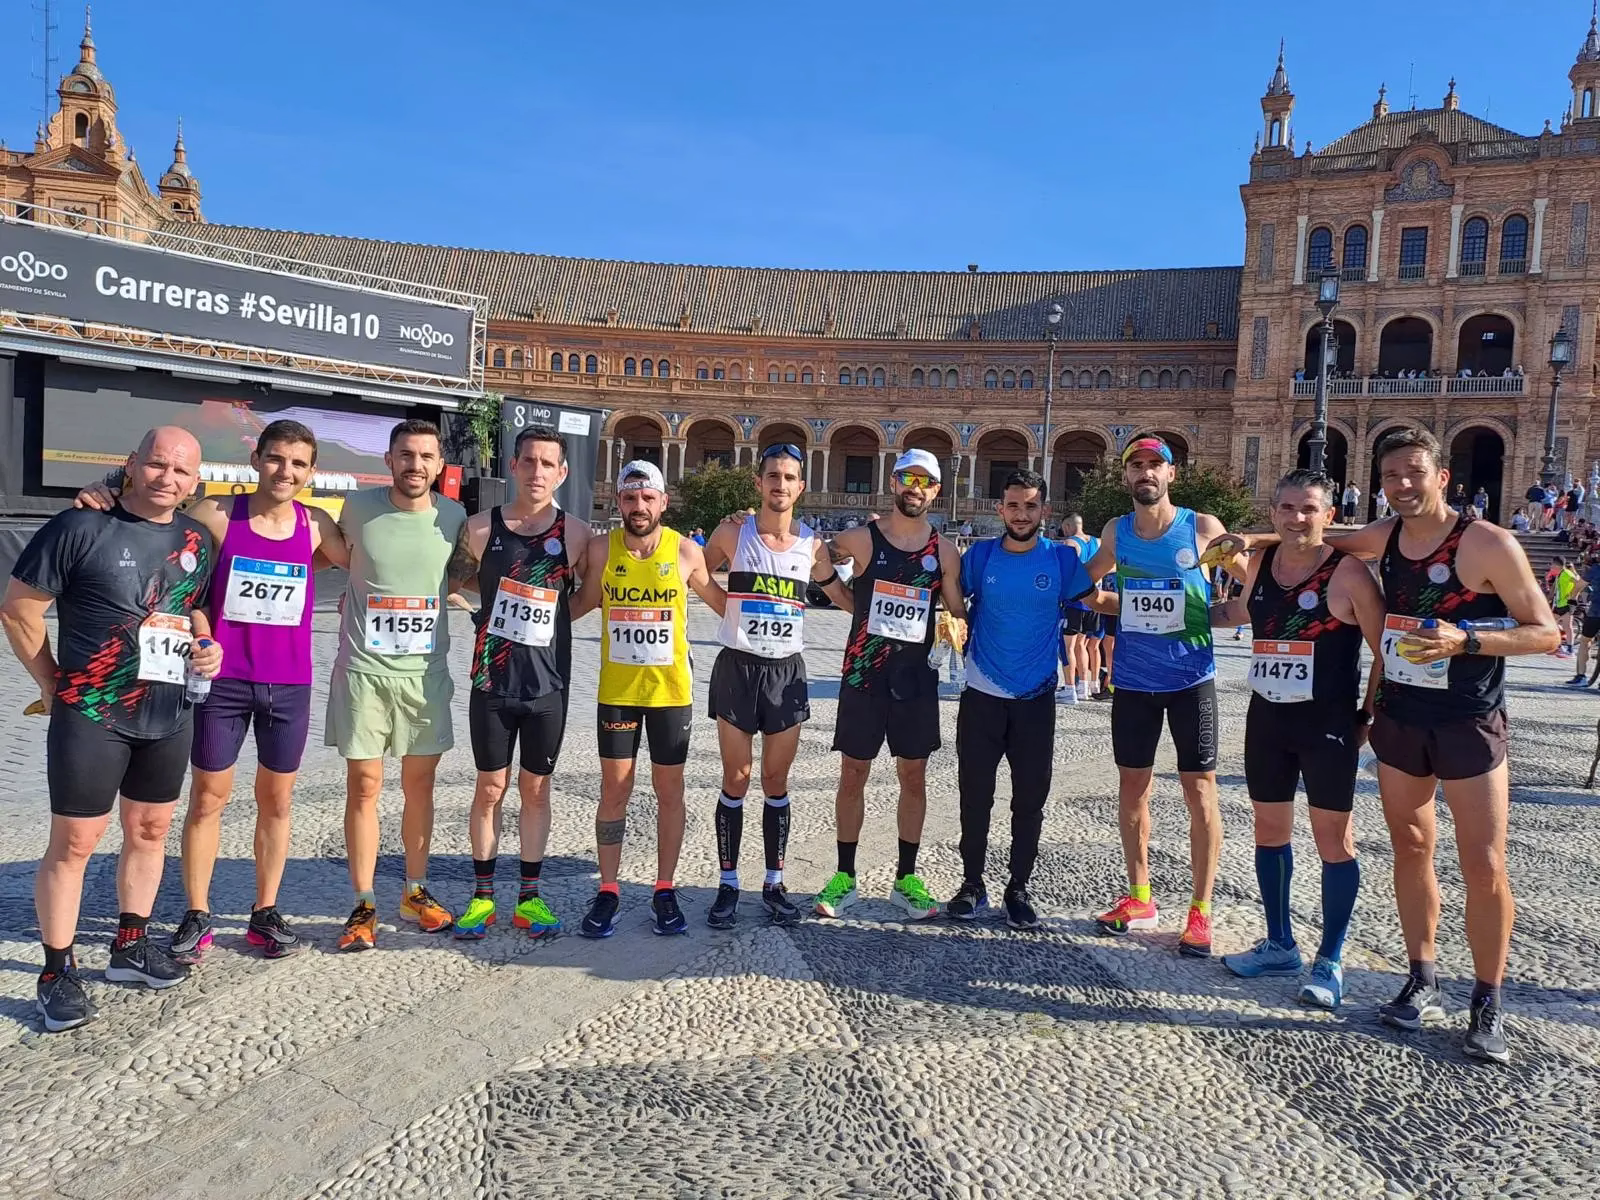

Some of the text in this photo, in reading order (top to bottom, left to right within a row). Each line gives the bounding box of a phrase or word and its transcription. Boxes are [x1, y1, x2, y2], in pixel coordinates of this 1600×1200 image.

[0, 250, 68, 282] O8DO
[94, 265, 381, 340] Carreras #Sevilla10
[532, 407, 551, 419] IMD
[238, 580, 296, 602] 2677
[752, 575, 795, 599] ASM
[499, 599, 551, 625] 11395
[875, 599, 927, 622] 19097
[1131, 596, 1175, 613] 1940
[371, 615, 435, 634] 11552
[747, 619, 794, 638] 2192
[612, 627, 670, 645] 11005
[1252, 660, 1309, 681] 11473
